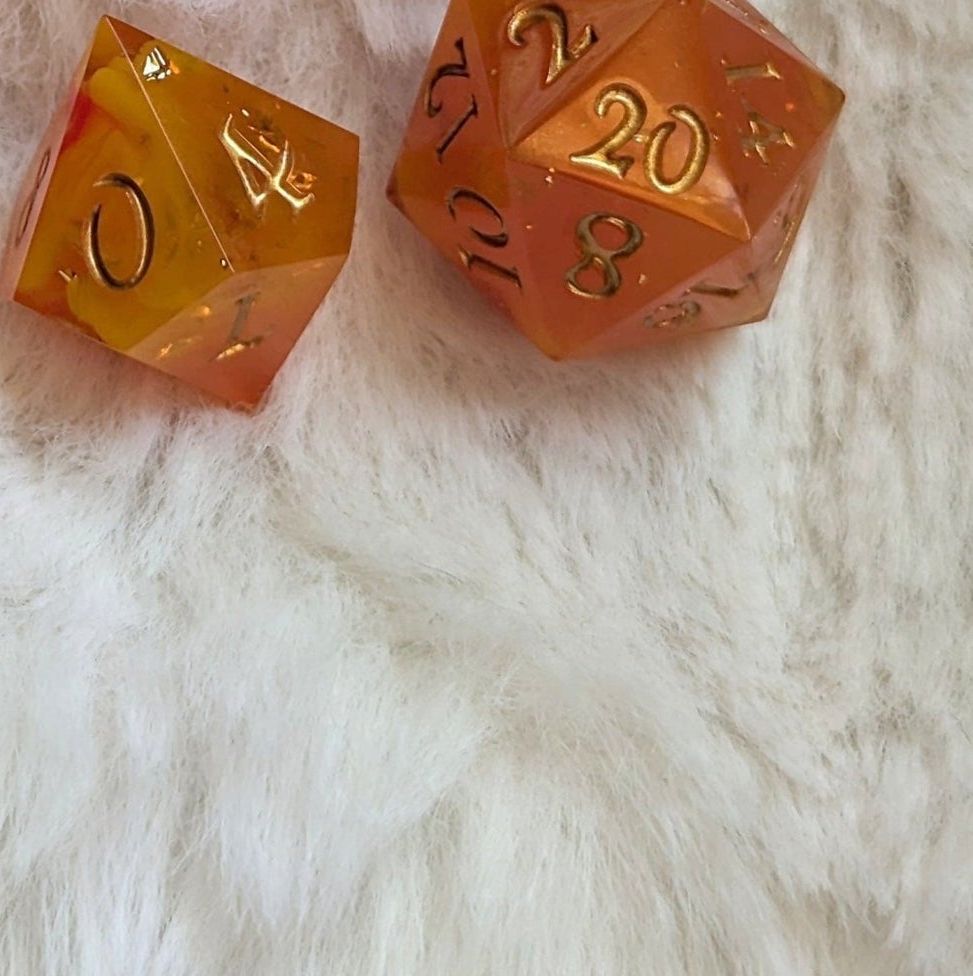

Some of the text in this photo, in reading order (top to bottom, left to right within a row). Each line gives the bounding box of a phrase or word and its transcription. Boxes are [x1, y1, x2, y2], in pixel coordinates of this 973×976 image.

[507, 1, 599, 86] 2
[219, 111, 315, 212] 4
[569, 81, 711, 196] 20
[87, 172, 155, 291] 0
[447, 186, 523, 293] 10
[564, 211, 645, 301] 8
